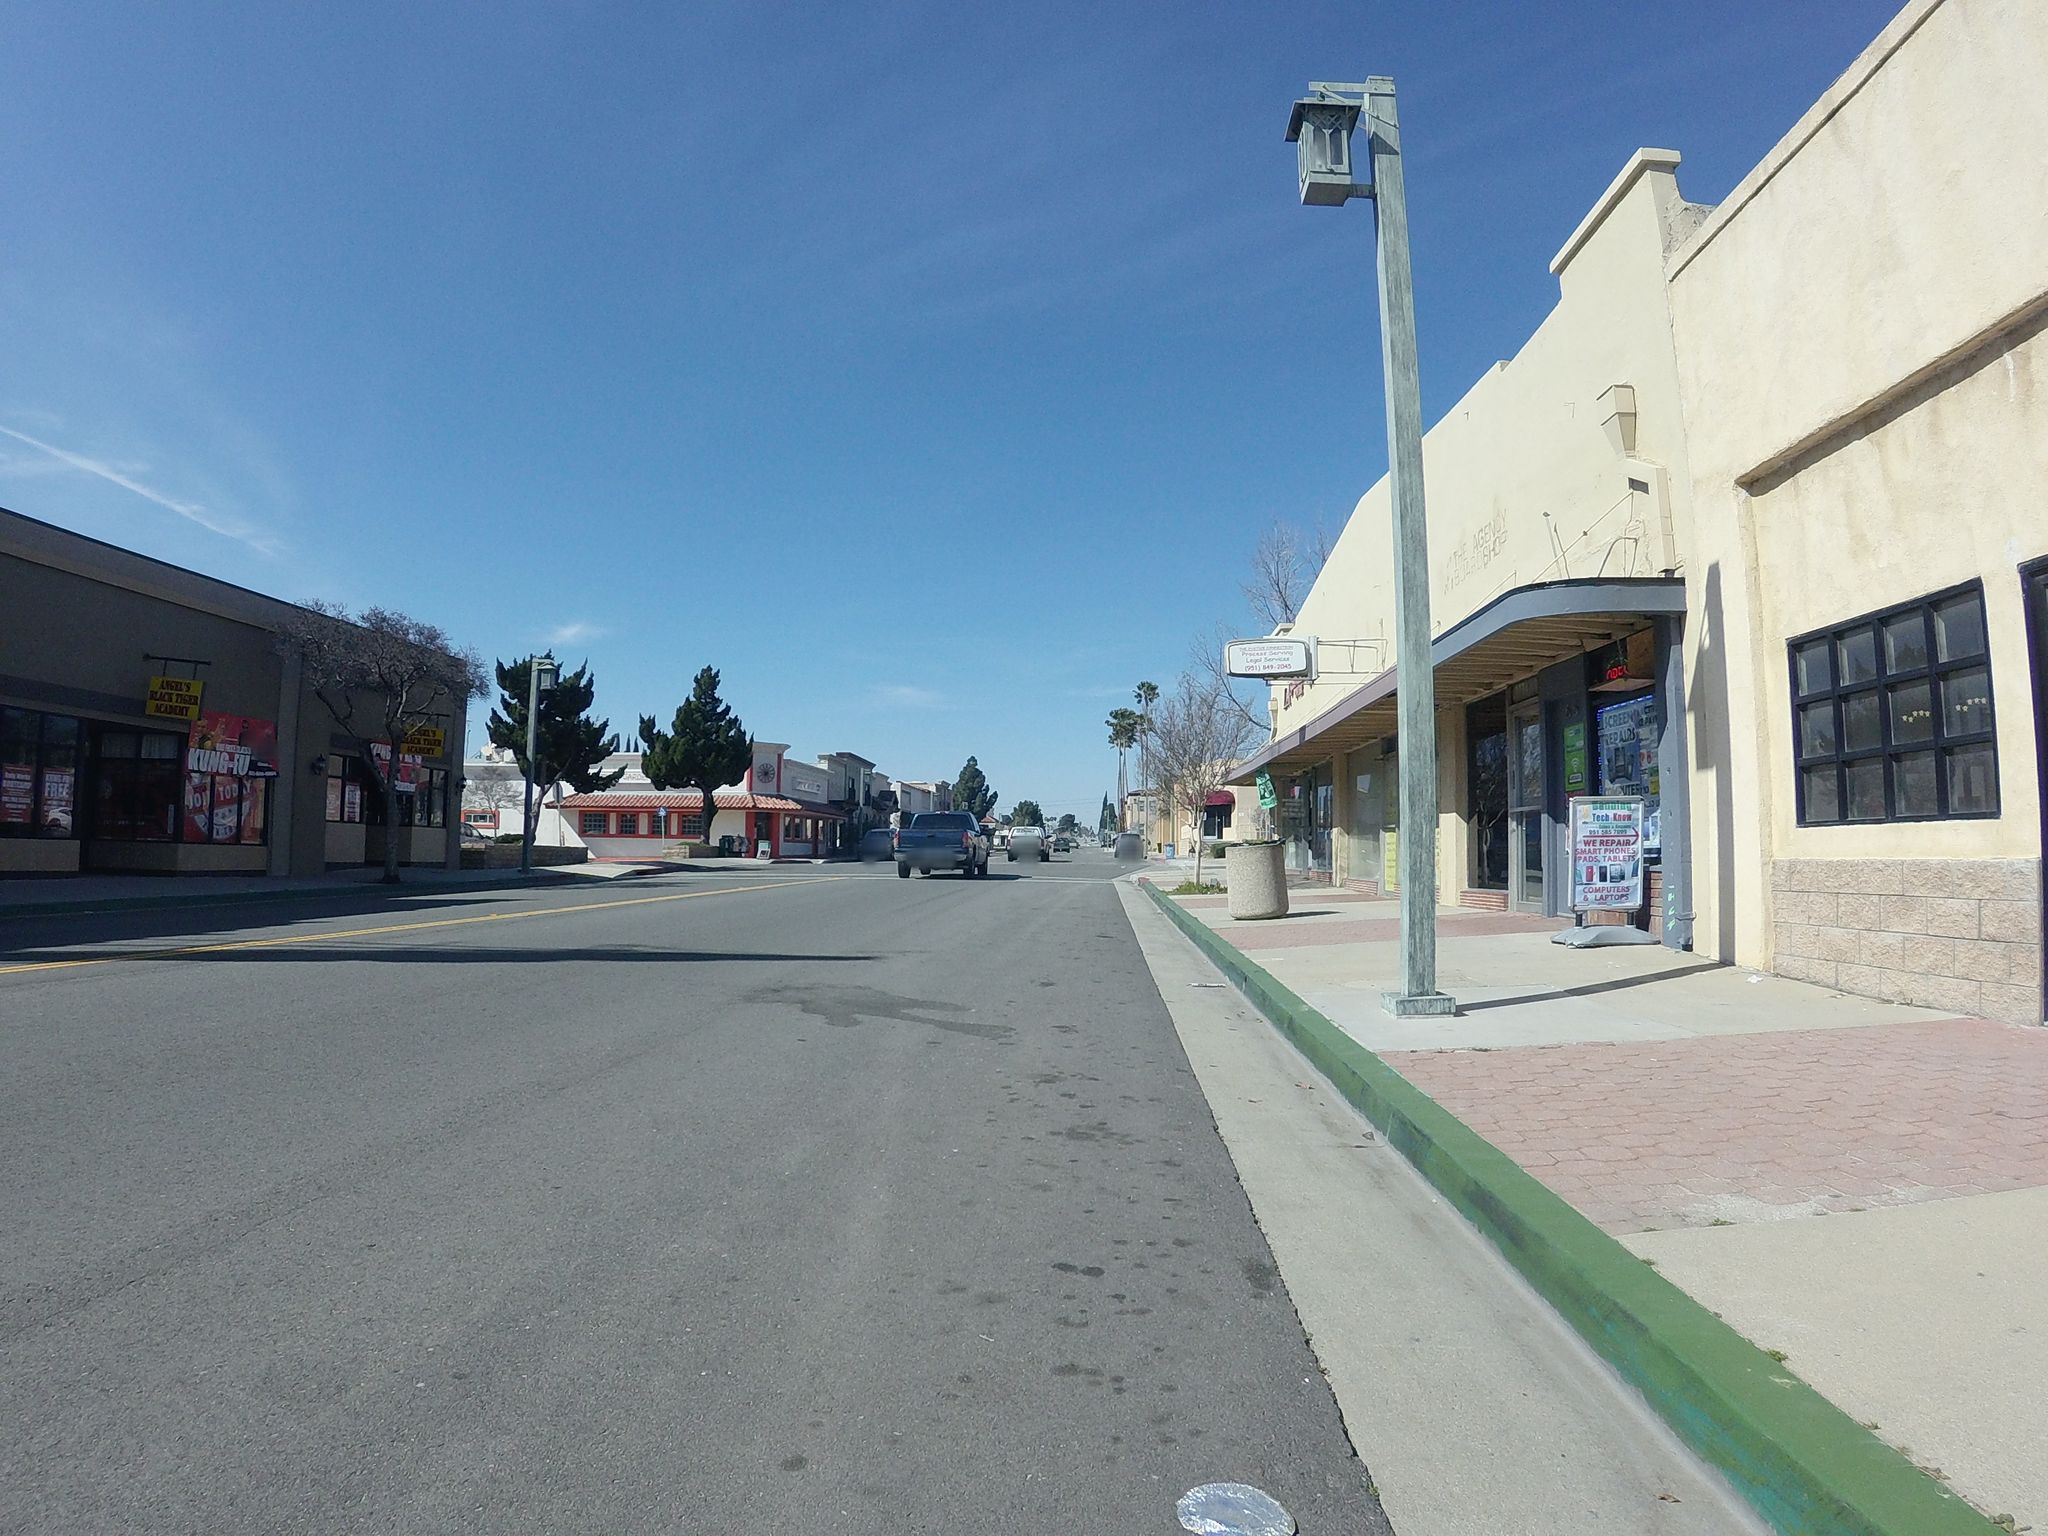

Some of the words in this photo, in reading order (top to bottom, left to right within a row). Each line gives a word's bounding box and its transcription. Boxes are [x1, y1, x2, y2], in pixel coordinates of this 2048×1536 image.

[158, 679, 191, 692] ANGEL'S
[149, 690, 173, 702] BLACK
[175, 693, 199, 706] TIGER
[153, 703, 189, 717] ACADEMY
[188, 751, 251, 776] KUNG-FU
[1592, 813, 1610, 821] Tech
[1613, 813, 1632, 821] Know
[1583, 839, 1597, 847] WE
[1599, 839, 1631, 847] REPAIR
[1604, 847, 1636, 855] PHONES
[1583, 885, 1630, 893] COMPUTERS
[1594, 893, 1630, 901] LAPTOPS
